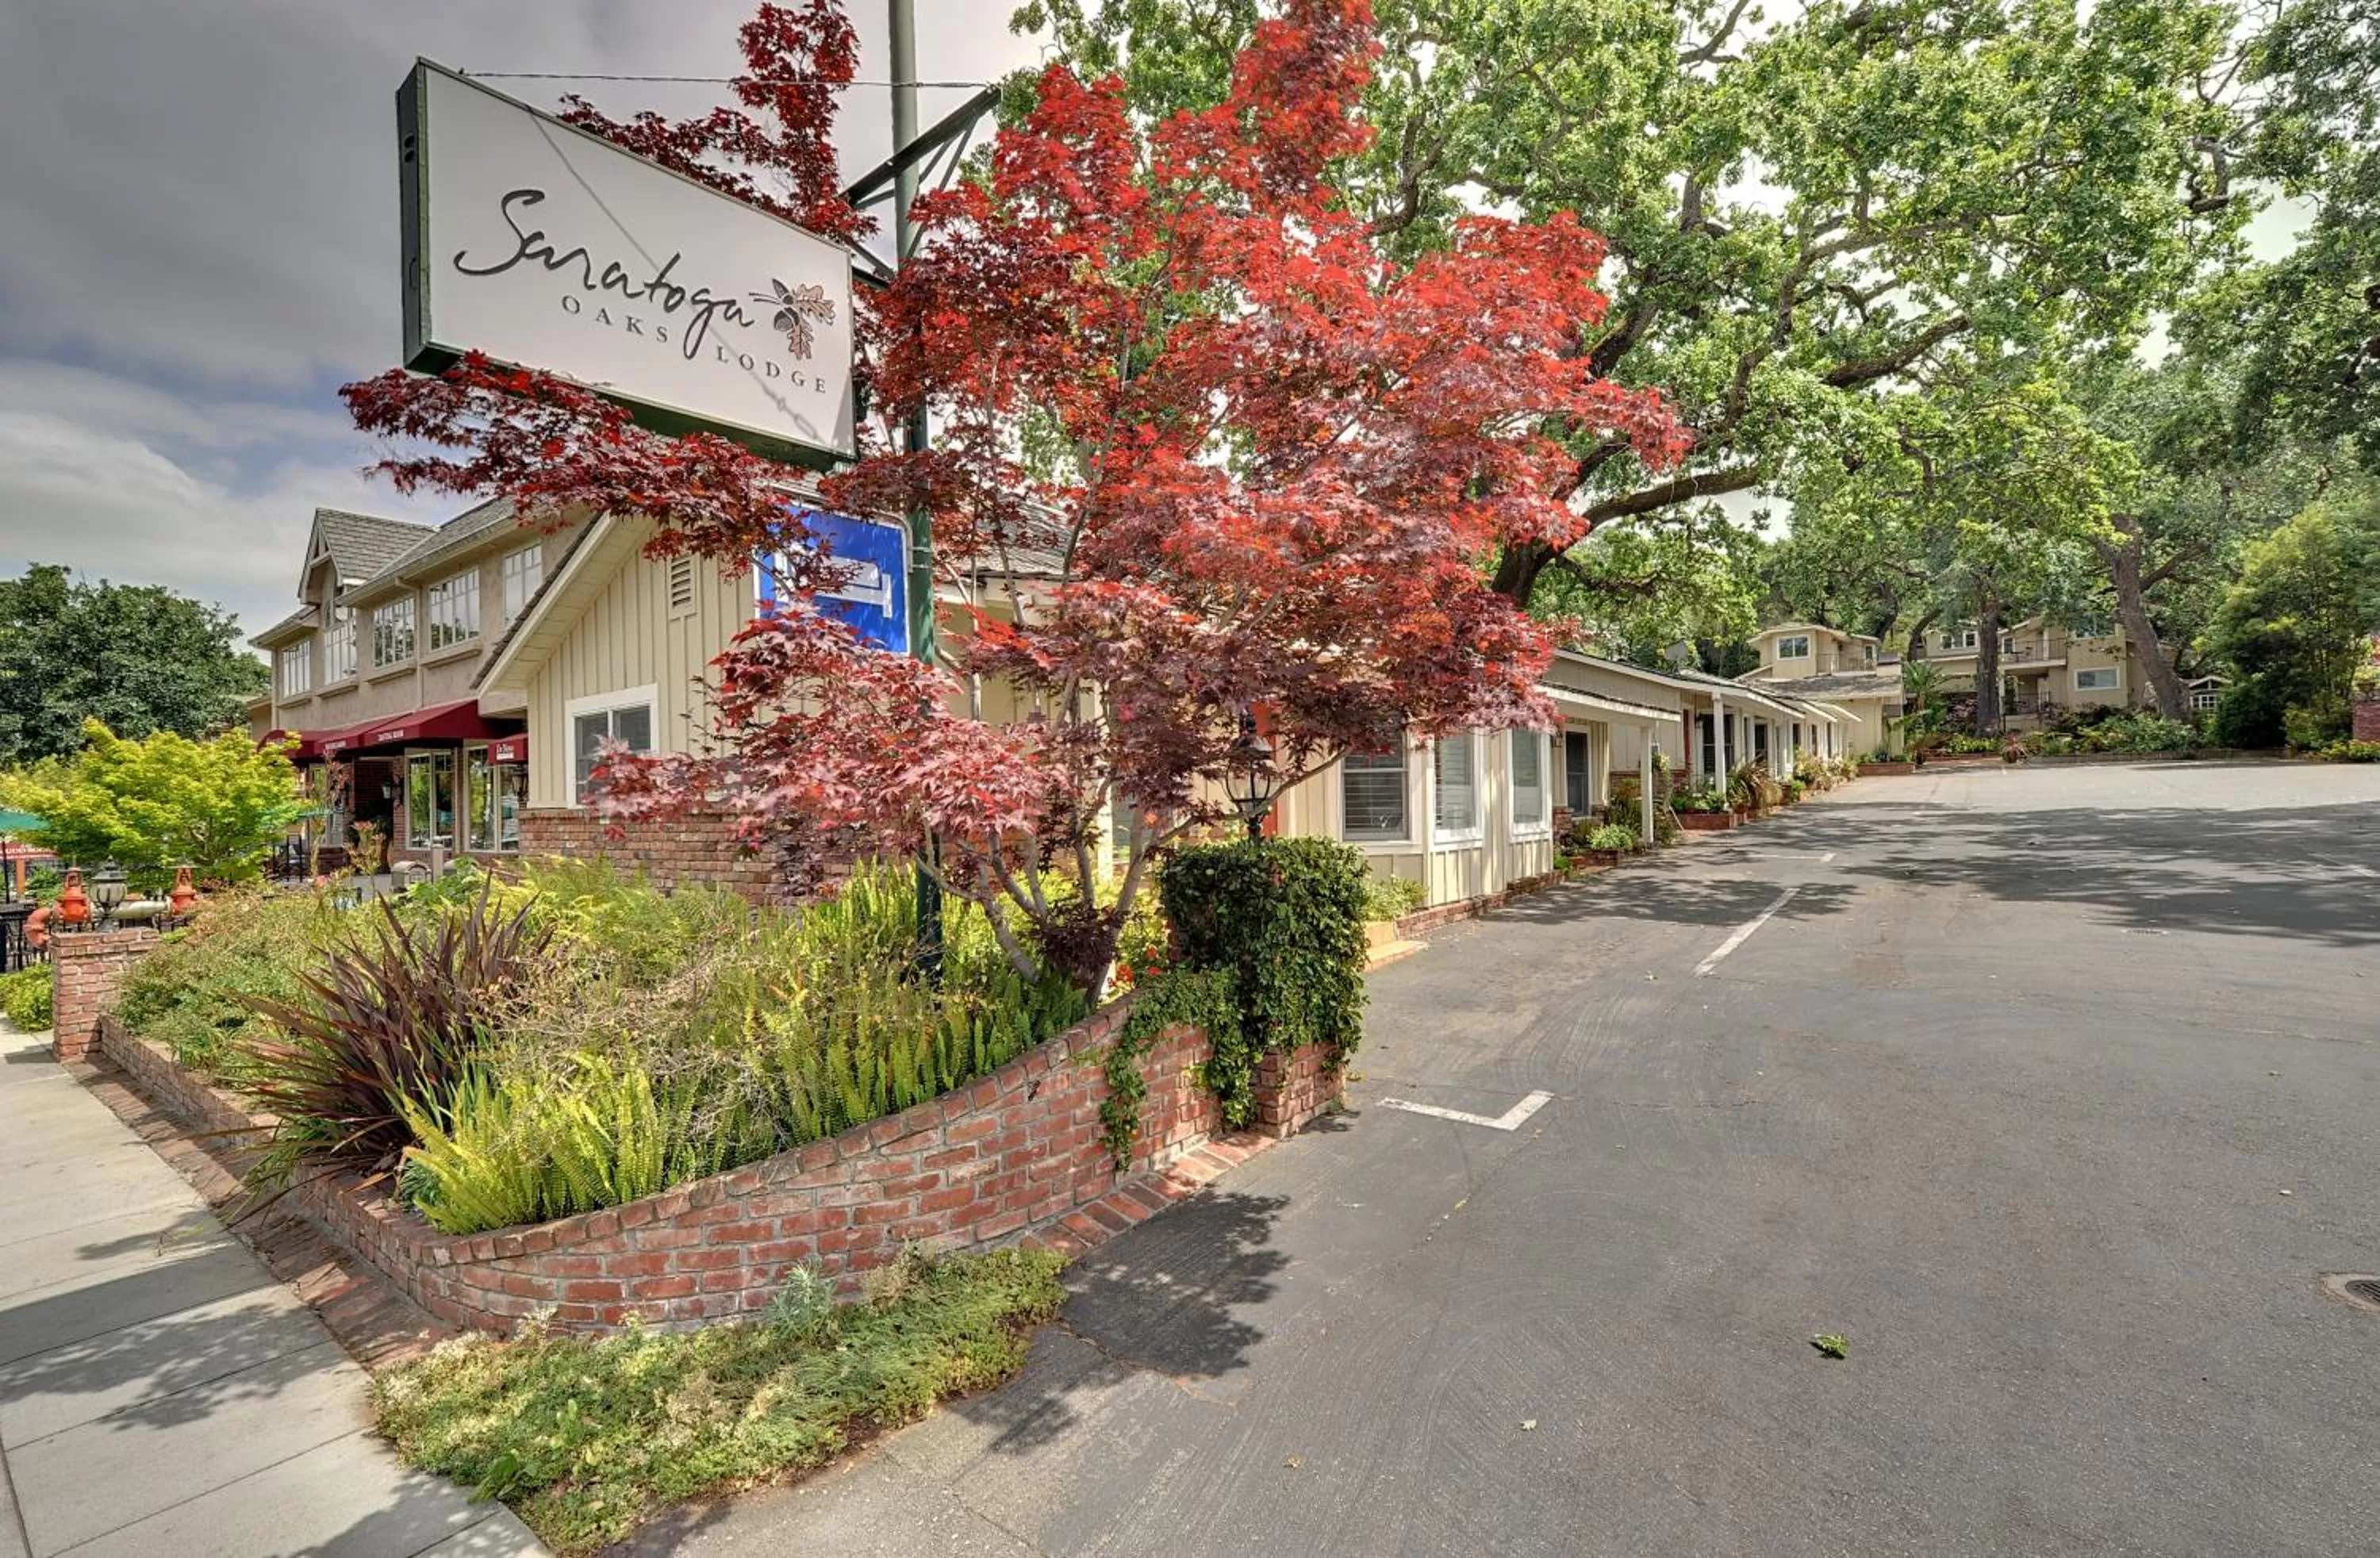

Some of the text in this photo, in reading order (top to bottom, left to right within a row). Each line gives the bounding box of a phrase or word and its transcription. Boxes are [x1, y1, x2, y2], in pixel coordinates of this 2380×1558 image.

[454, 189, 754, 359] Saratoga
[562, 294, 826, 393] OAKS LODGE
